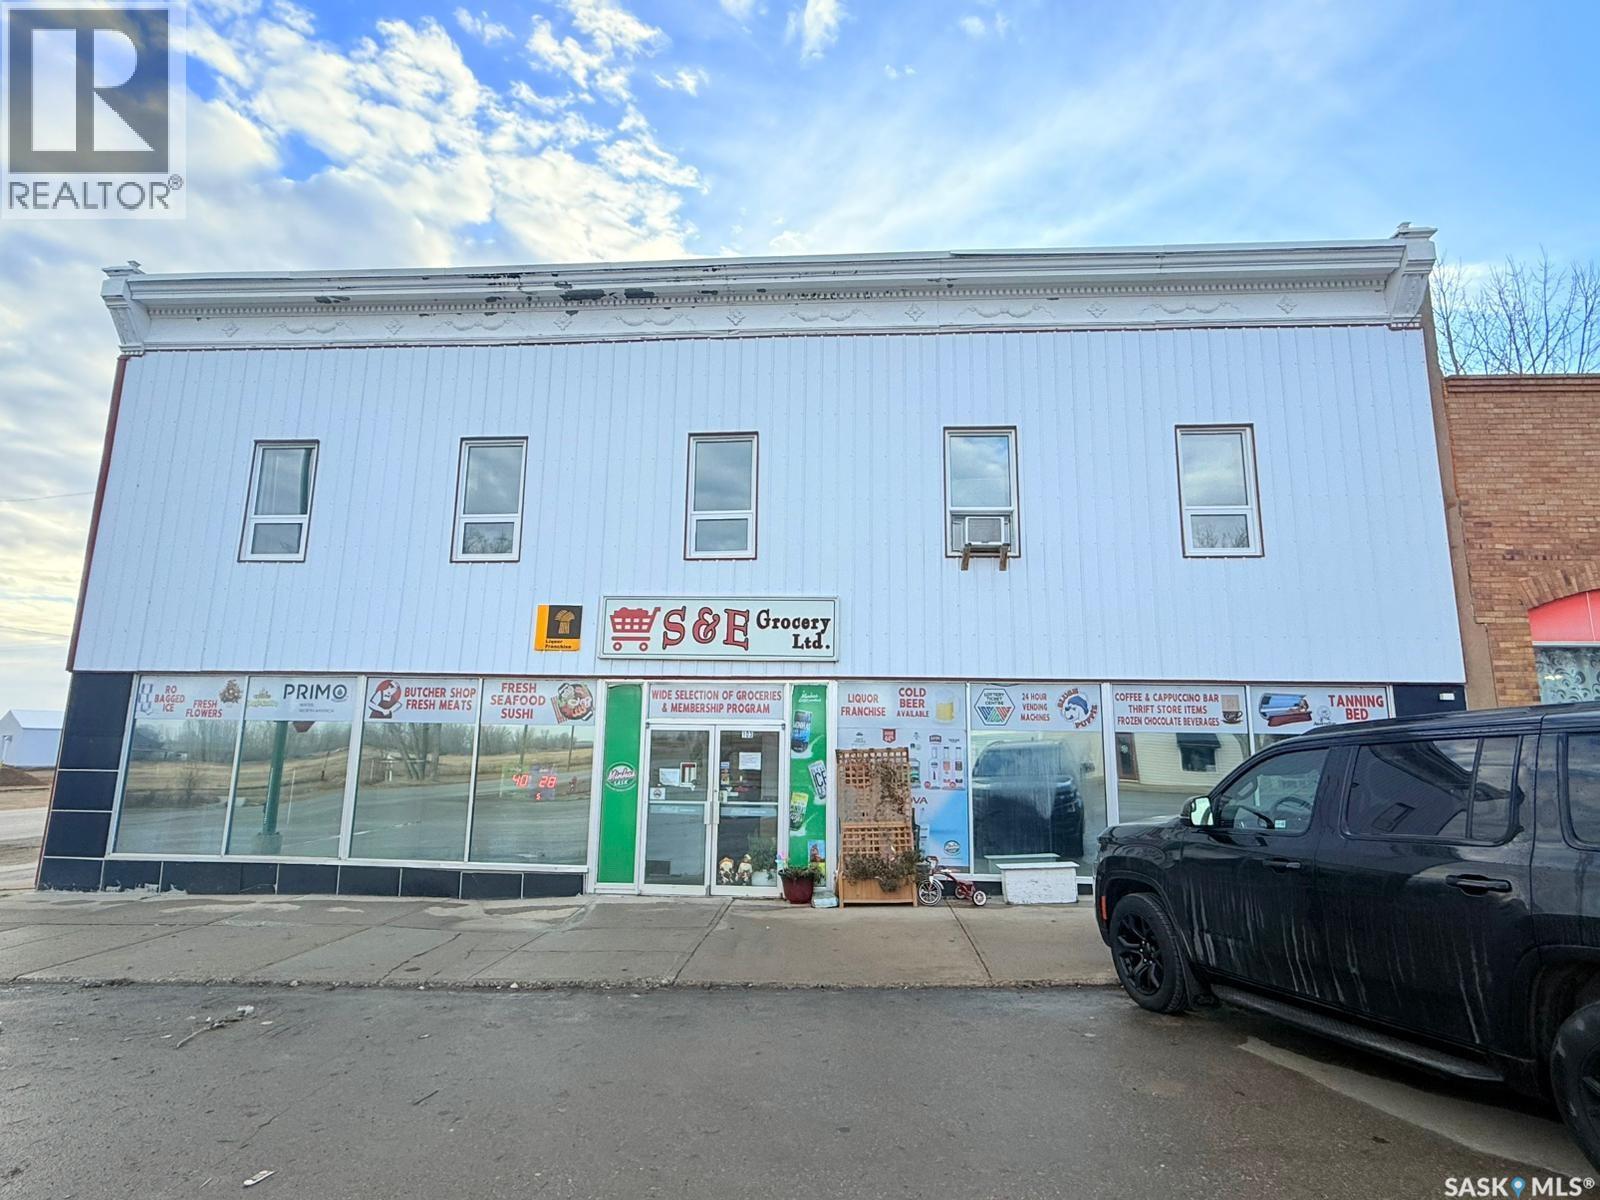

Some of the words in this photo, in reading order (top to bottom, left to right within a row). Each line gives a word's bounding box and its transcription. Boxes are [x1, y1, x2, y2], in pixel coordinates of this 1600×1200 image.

[756, 609, 831, 634] Grocery
[792, 632, 831, 650] Ltd.
[165, 685, 178, 694] RO
[283, 684, 347, 700] PRIMO
[404, 686, 447, 698] BUTCHER
[450, 687, 477, 699] SHOP
[501, 682, 537, 693] FRESH
[898, 687, 927, 698] COLD
[153, 694, 186, 703] BAGGED
[490, 694, 546, 706] SEAFOOD
[651, 689, 672, 700] WIDE
[674, 690, 720, 700] SELECTION
[722, 690, 733, 700] OF
[736, 690, 782, 701] GROCERIES
[847, 693, 879, 704] LIQUOR
[1115, 692, 1142, 702] COFFEE
[1144, 693, 1150, 702] &
[1152, 693, 1201, 702] CAPPUCCINO
[1203, 693, 1220, 703] BAR
[192, 699, 218, 709] FRESH
[405, 699, 436, 711] FRESH
[438, 699, 473, 711] MEATS
[899, 698, 925, 709] BEER
[1327, 694, 1384, 708] TANNING
[162, 703, 175, 712] ICE
[661, 703, 668, 712] &
[670, 703, 725, 713] MEMBERSHIP
[726, 704, 770, 714] PROGRAM
[840, 706, 886, 717] FRANCHISE
[1022, 703, 1048, 711] VENDING
[1128, 704, 1155, 714] THRIFT
[1157, 704, 1182, 714] STORE
[1184, 705, 1208, 714] ITEMS
[185, 708, 223, 718] FLOWERS
[500, 707, 534, 720] SUSHI
[896, 709, 930, 718] AVAILABLE
[1020, 713, 1050, 721] MACHINES
[1345, 708, 1369, 720] BED
[1117, 716, 1143, 726] FROZEN
[1144, 717, 1182, 726] CHOCOLATE
[1183, 717, 1220, 727] BEVERAGES
[511, 773, 529, 789] 40
[538, 775, 558, 789] 28
